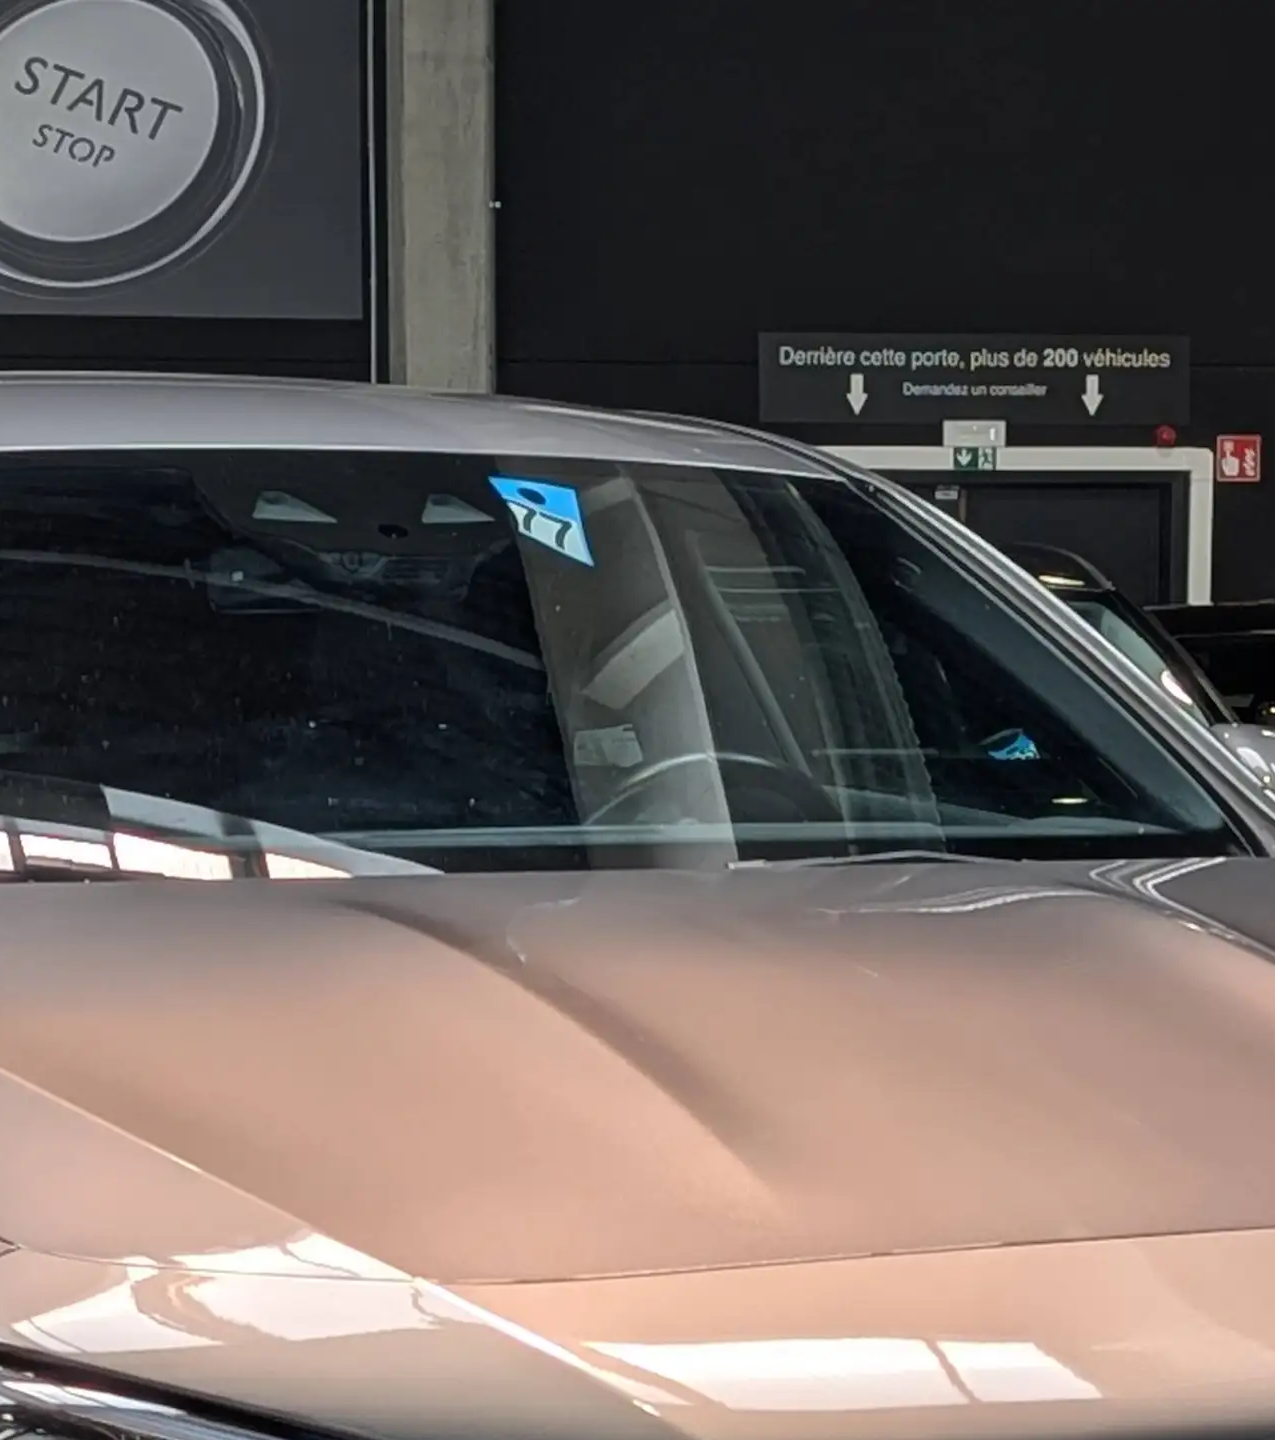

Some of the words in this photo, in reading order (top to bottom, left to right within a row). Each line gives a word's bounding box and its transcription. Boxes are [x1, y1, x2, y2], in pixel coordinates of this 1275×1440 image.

[14, 56, 184, 140] START
[32, 123, 116, 168] STOP
[778, 346, 856, 367] Derrière
[859, 349, 907, 367] cette
[911, 349, 966, 371] porte,
[970, 348, 1010, 371] plus
[1013, 348, 1038, 368] de
[1042, 349, 1079, 368] 200
[1083, 347, 1171, 368] véhicules
[971, 384, 987, 396] un
[508, 500, 573, 551] 77
